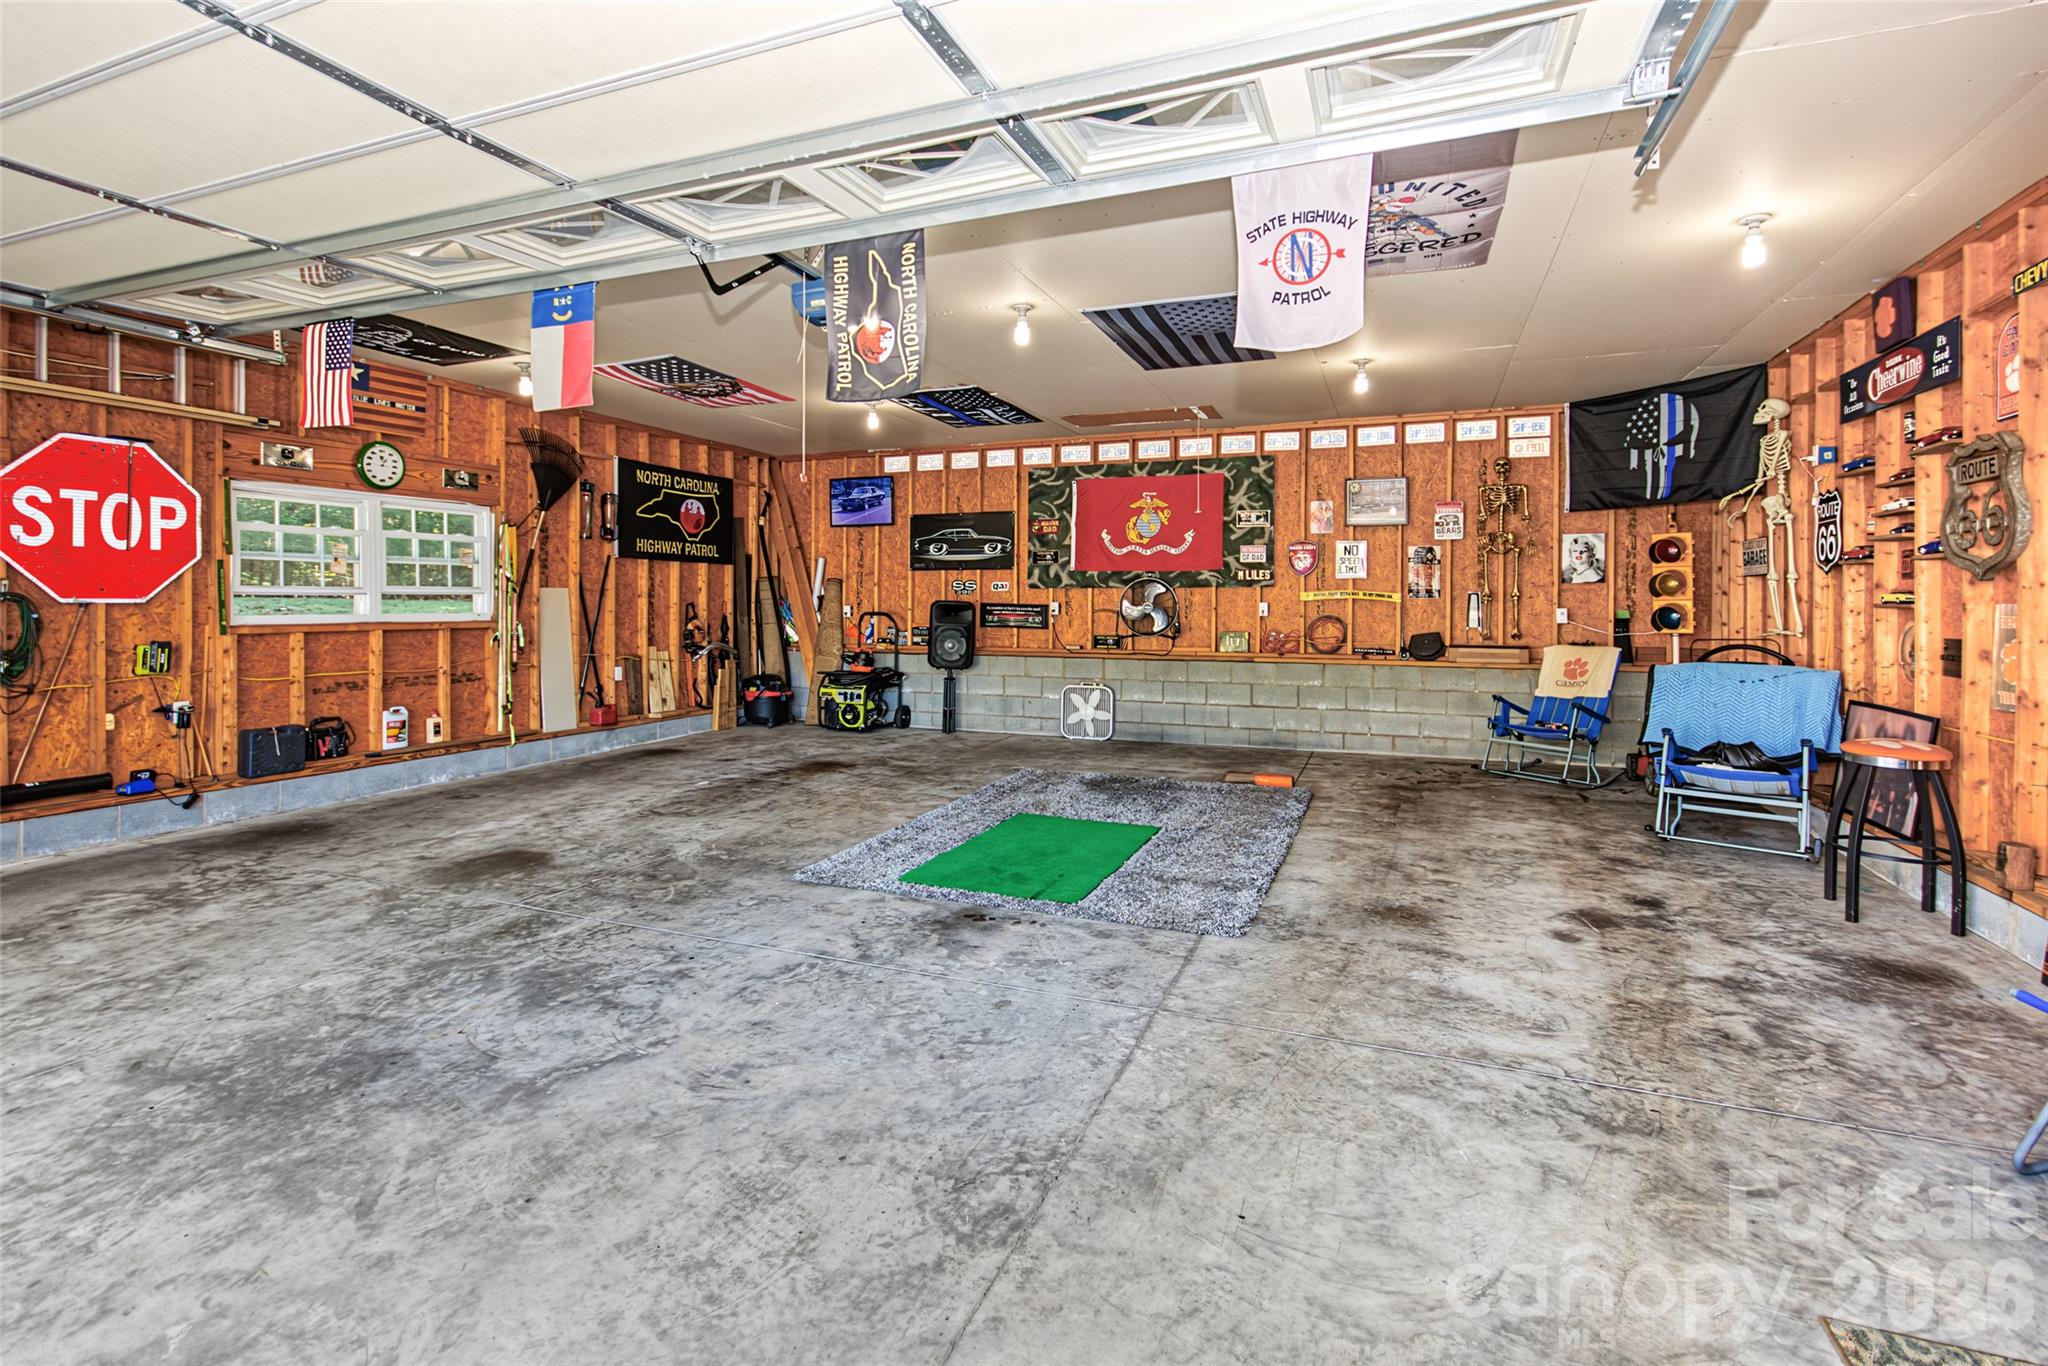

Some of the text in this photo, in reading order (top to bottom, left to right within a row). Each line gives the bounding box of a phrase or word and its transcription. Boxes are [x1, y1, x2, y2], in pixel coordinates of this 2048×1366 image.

[1246, 209, 1359, 244] STATE HIGHWAY
[2014, 258, 2048, 293] CHEVY
[1271, 285, 1332, 305] PATROL
[832, 255, 852, 392] HIGHWAY PATROL
[900, 242, 920, 383] NORTH CAROLINA
[1867, 354, 1923, 402] Cheerwine
[636, 468, 720, 495] NORTH CAROLINA
[1961, 457, 1996, 480] ROUTE
[9, 485, 188, 551] STOP
[1817, 501, 1839, 518] ROUTE
[1955, 482, 2004, 549] 66
[636, 538, 719, 557] HIGHWAY PATROL
[1343, 544, 1359, 556] NO
[1818, 524, 1836, 561] 66
[952, 580, 977, 591] SS
[1339, 566, 1361, 574] LIMI
